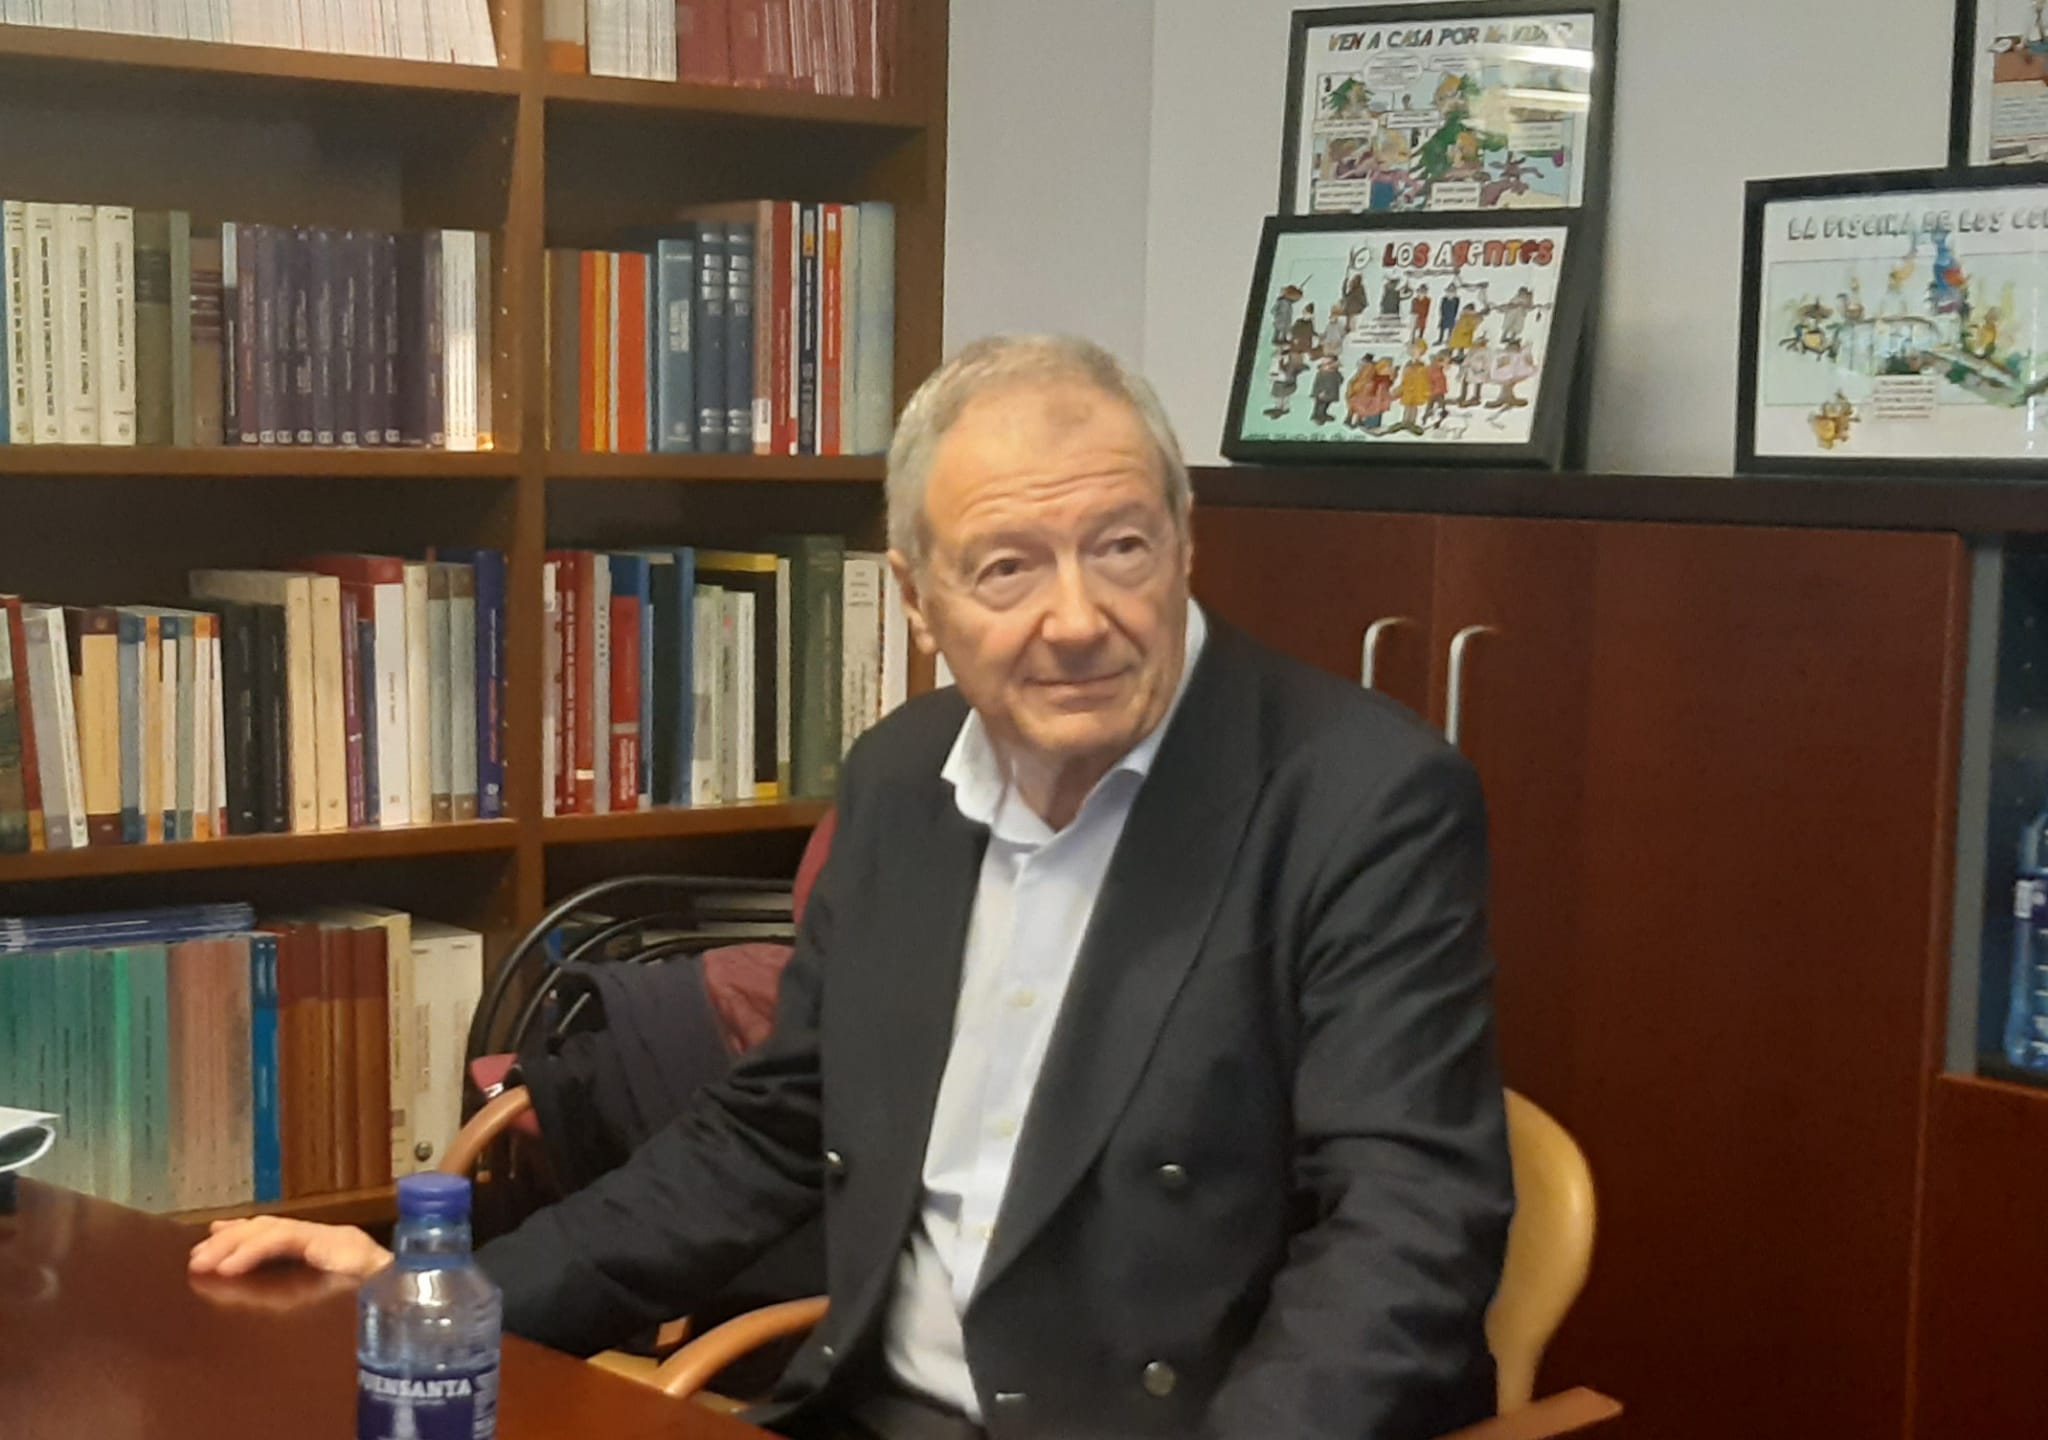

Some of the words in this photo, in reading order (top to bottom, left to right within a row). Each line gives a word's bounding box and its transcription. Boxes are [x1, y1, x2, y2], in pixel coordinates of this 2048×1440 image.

[1329, 32, 1365, 51] VEN
[1367, 31, 1381, 50] A
[1386, 28, 1434, 49] CASA
[1438, 26, 1480, 47] POR
[1381, 242, 1431, 268] LOS
